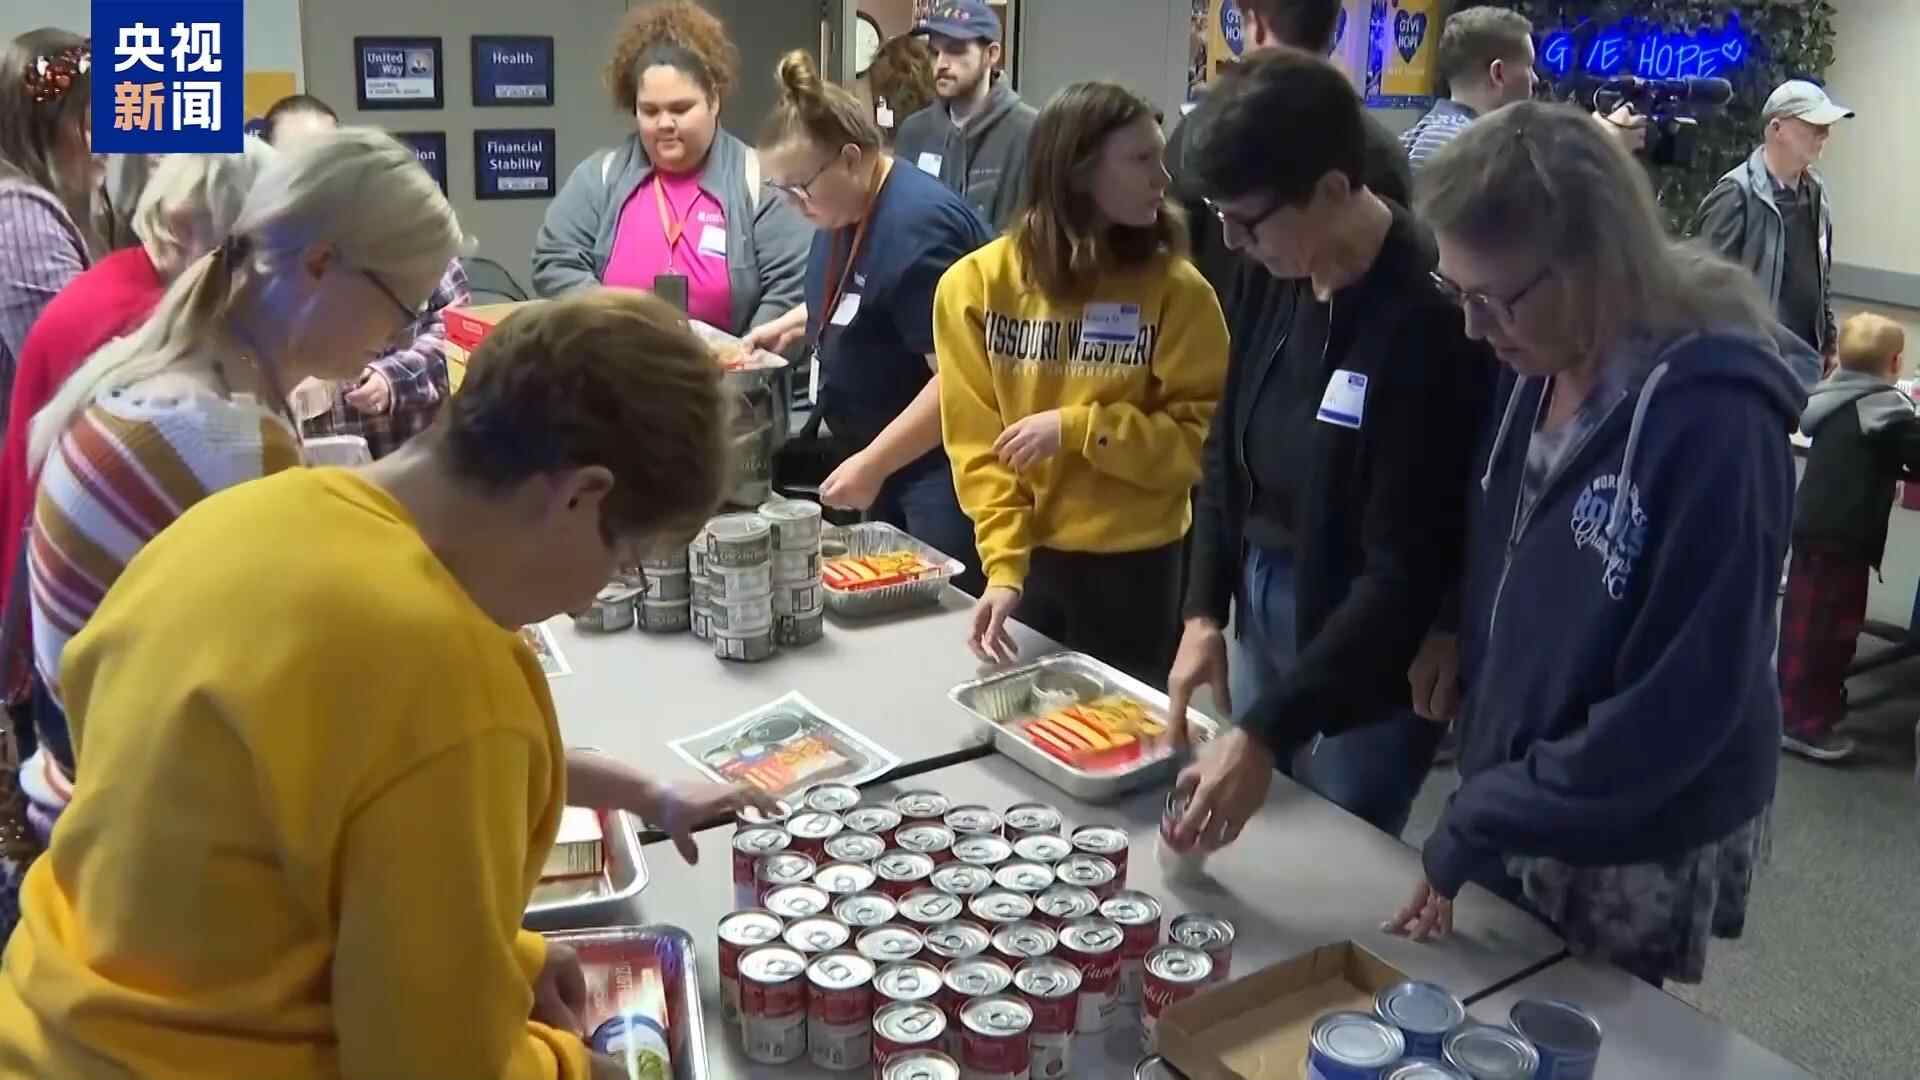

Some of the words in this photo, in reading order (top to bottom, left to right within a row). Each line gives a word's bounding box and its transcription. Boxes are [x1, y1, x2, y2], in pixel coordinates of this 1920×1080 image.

[367, 53, 403, 64] United
[492, 52, 534, 65] Health
[1638, 36, 1720, 79] HOPE
[382, 64, 404, 76] Way
[487, 141, 543, 152] Financial
[489, 158, 542, 171] Stability
[984, 311, 1061, 361] ISSOURI
